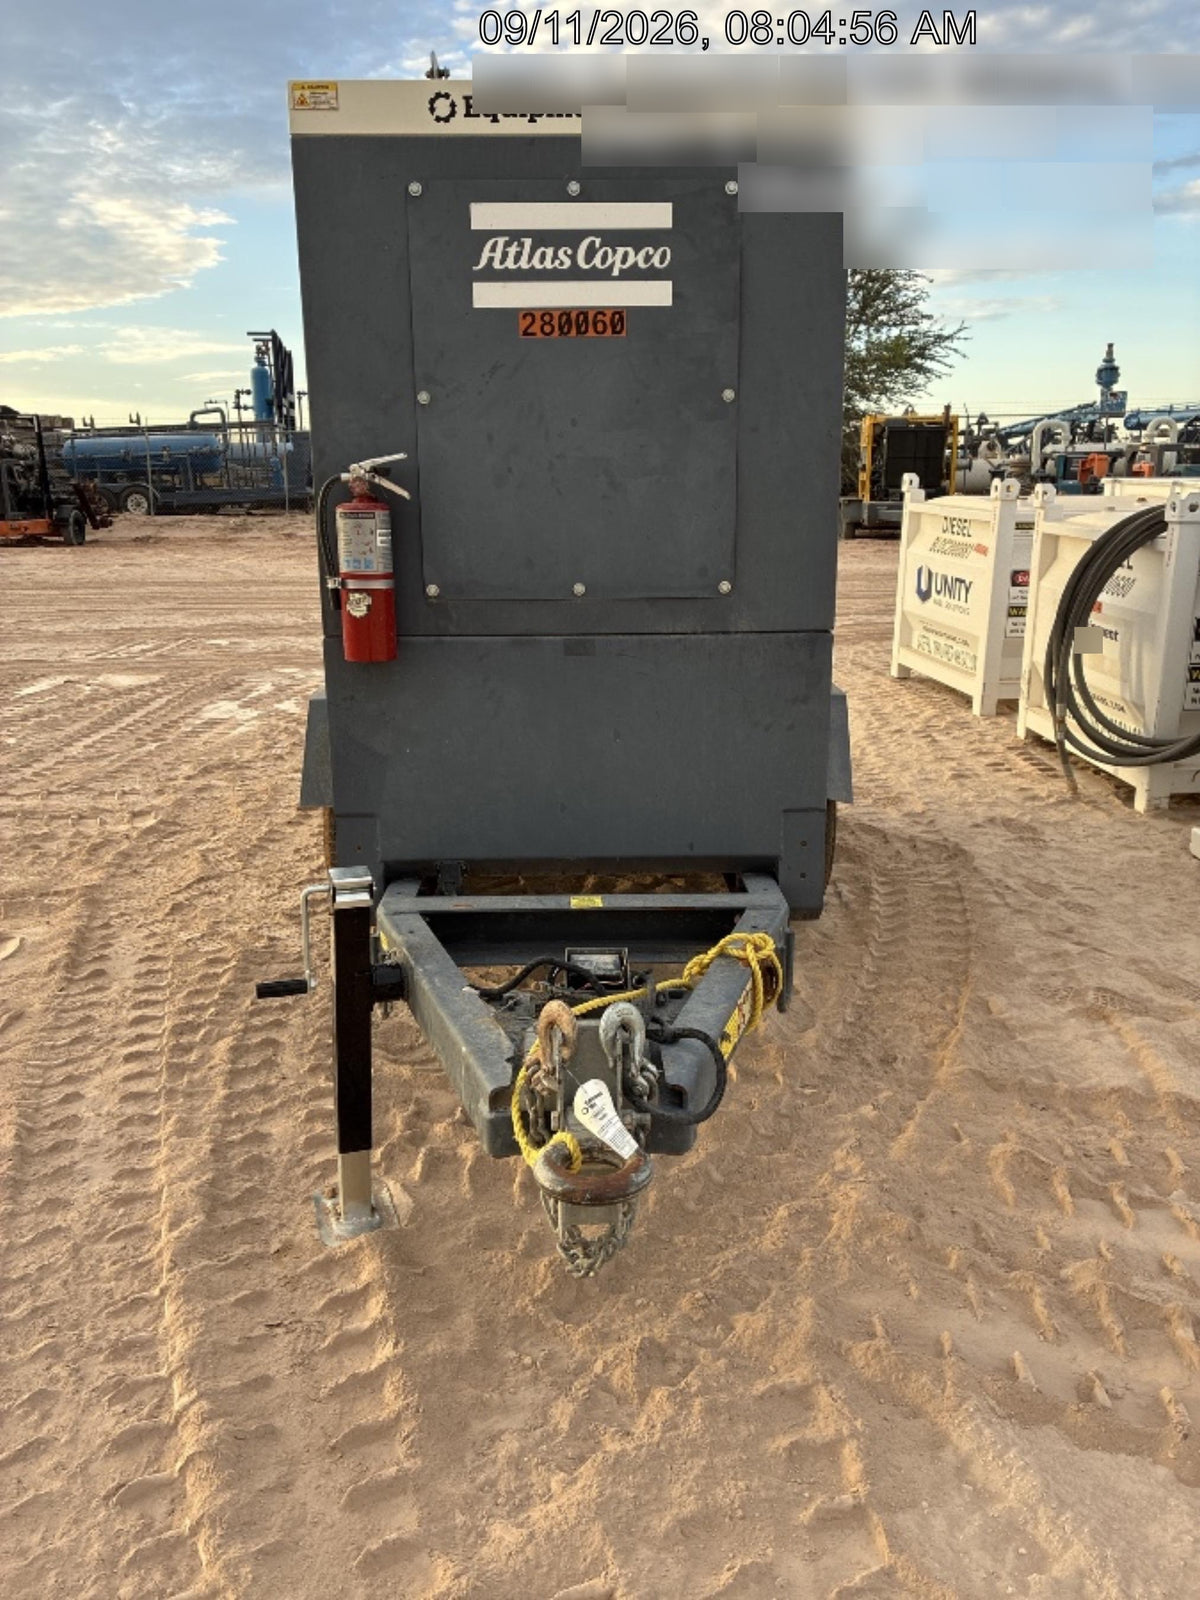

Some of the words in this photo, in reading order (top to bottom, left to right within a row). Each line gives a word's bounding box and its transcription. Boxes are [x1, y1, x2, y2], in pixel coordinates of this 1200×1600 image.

[472, 236, 573, 270] Atlas
[577, 236, 671, 276] Copco
[521, 310, 626, 337] 280060
[942, 516, 972, 537] DIESEL
[934, 572, 973, 603] UNITY
